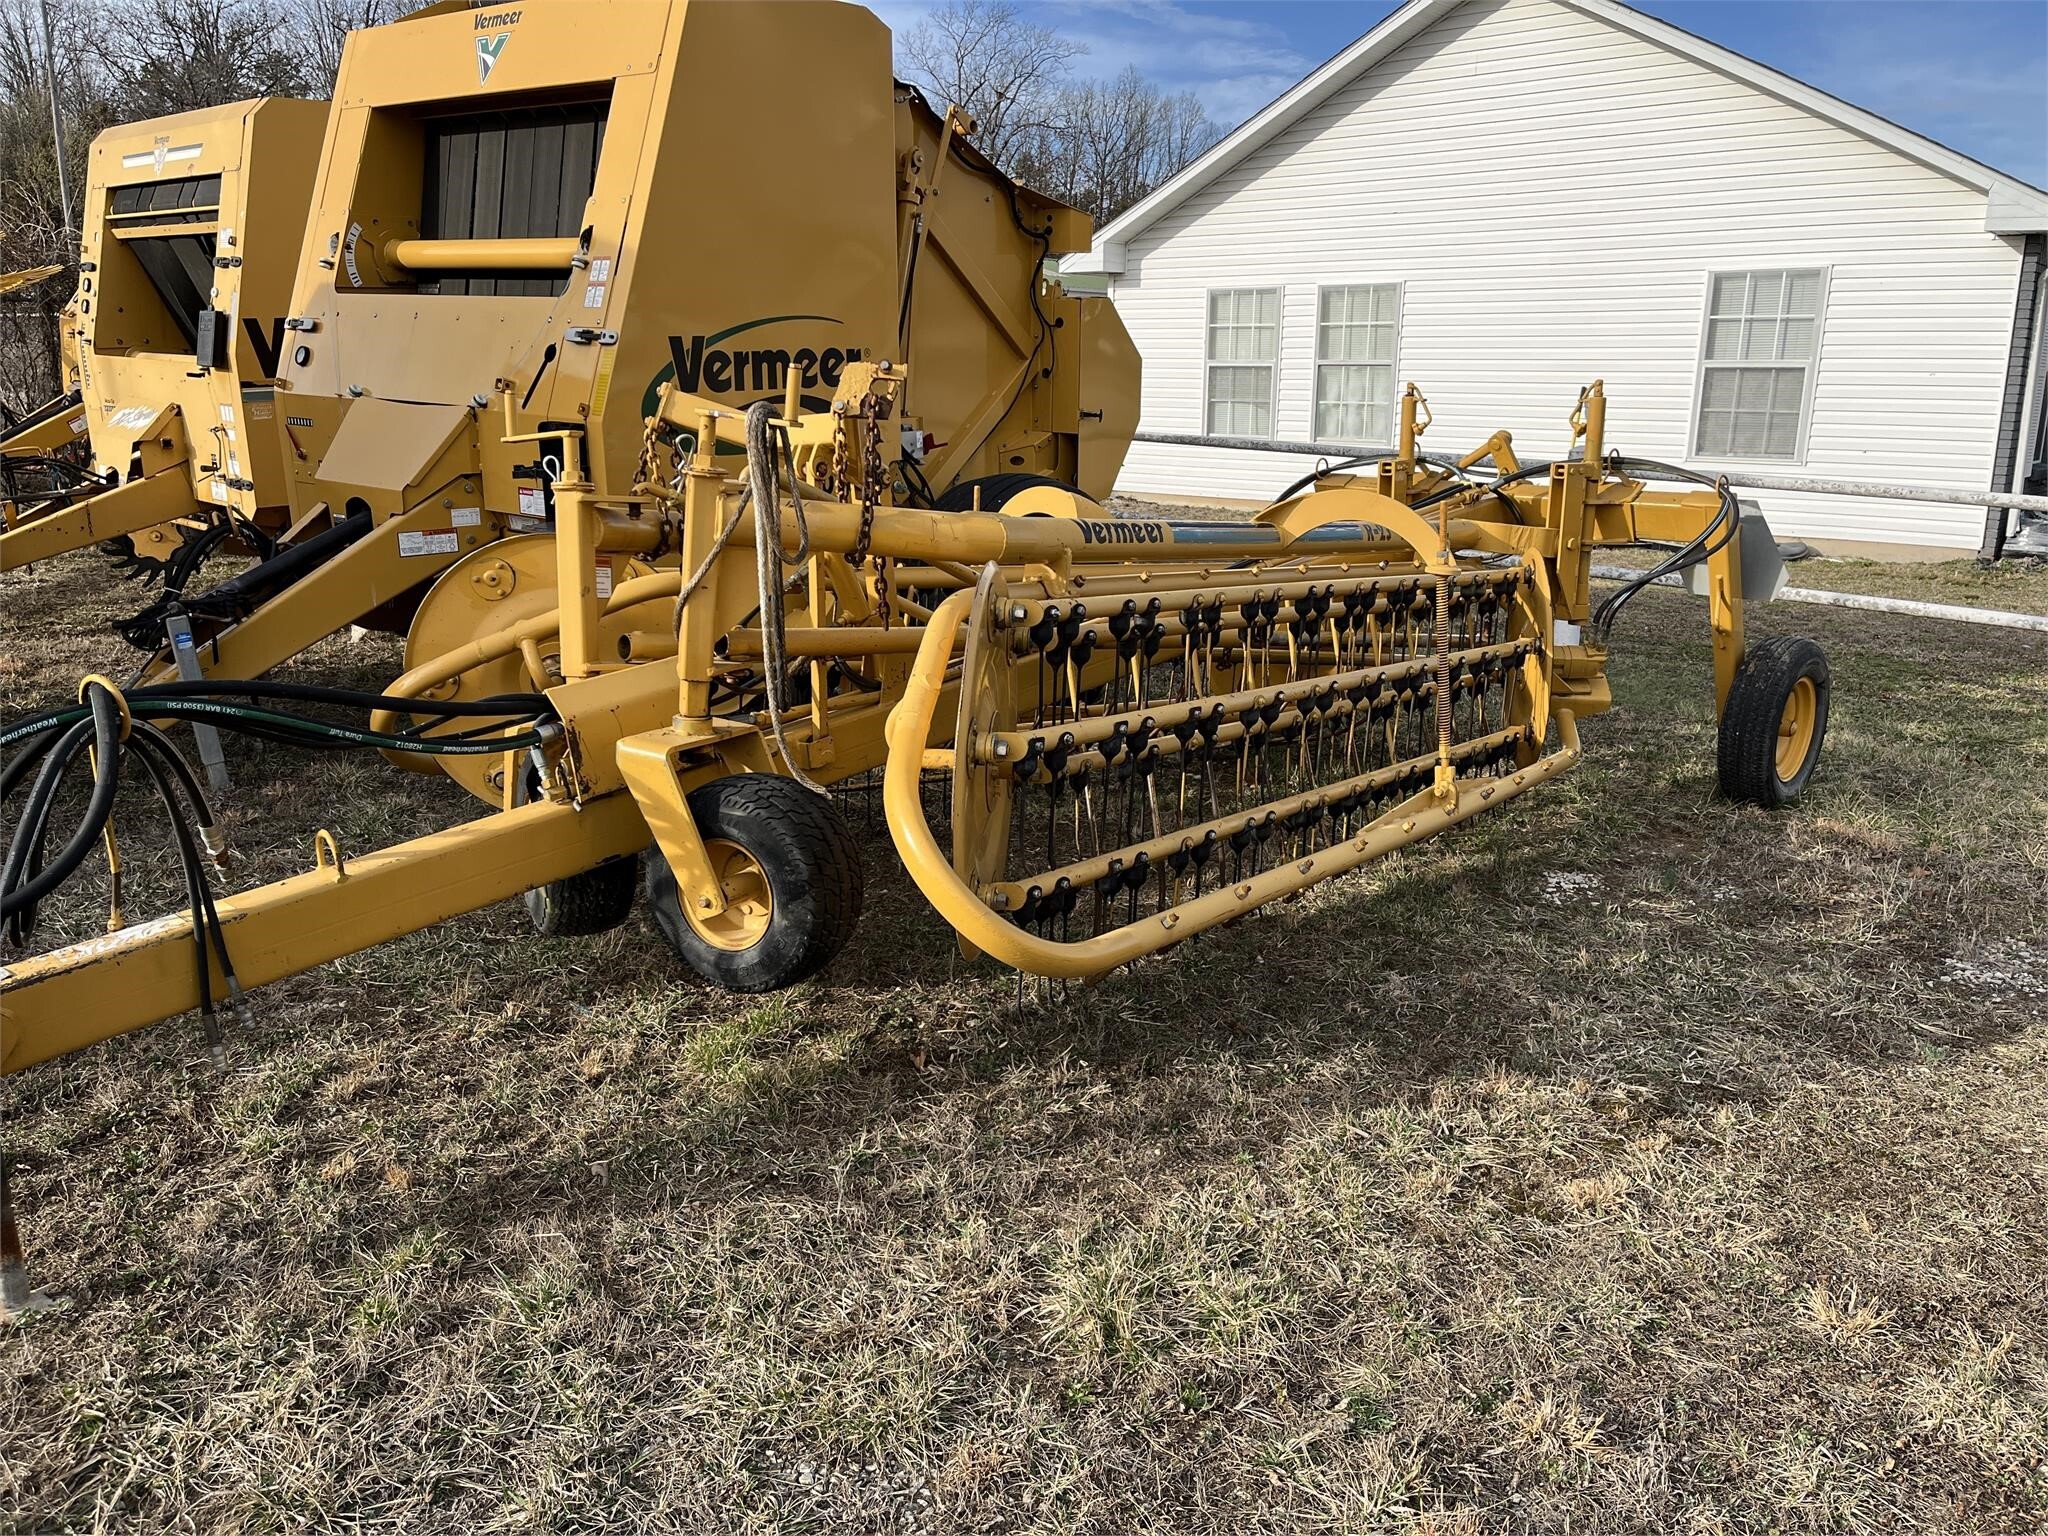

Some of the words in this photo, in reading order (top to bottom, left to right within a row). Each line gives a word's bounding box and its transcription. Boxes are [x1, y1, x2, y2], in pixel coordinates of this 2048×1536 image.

[473, 10, 523, 31] Vermeer
[1071, 519, 1164, 544] Vermeer
[167, 701, 181, 709] PSI)
[183, 702, 205, 711] (3500
[205, 704, 220, 713] BAR
[0, 717, 58, 746] Weatherhea
[329, 728, 343, 738] Tuff
[345, 731, 363, 741] Dura
[442, 745, 489, 753] Weatherhead
